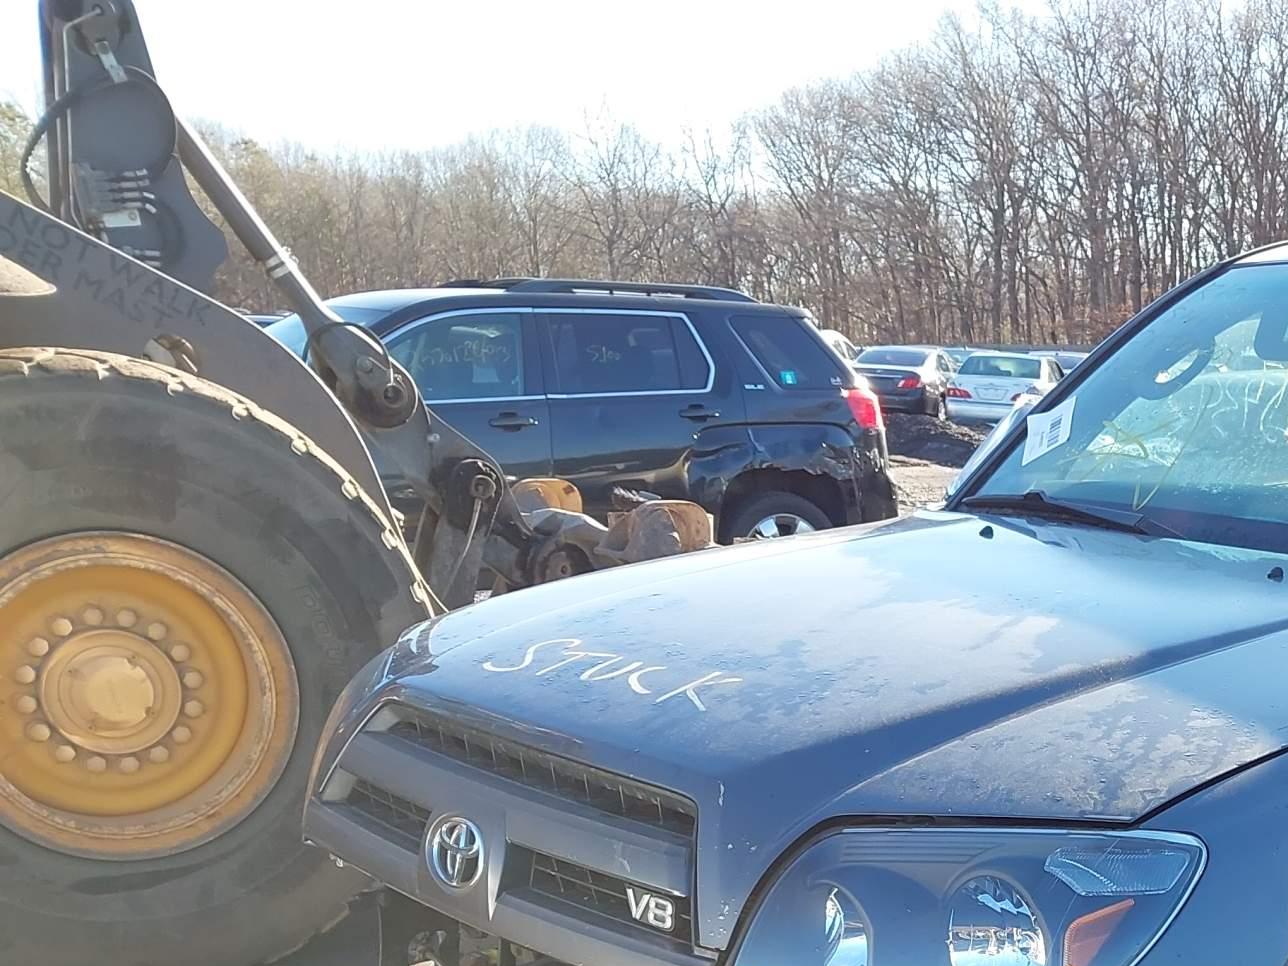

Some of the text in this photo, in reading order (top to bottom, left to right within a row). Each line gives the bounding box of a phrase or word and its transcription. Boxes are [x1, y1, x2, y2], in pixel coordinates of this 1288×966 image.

[8, 204, 211, 327] NOT WALK
[73, 269, 173, 328] MAST
[482, 638, 744, 712] STUCK
[625, 890, 674, 929] V8
